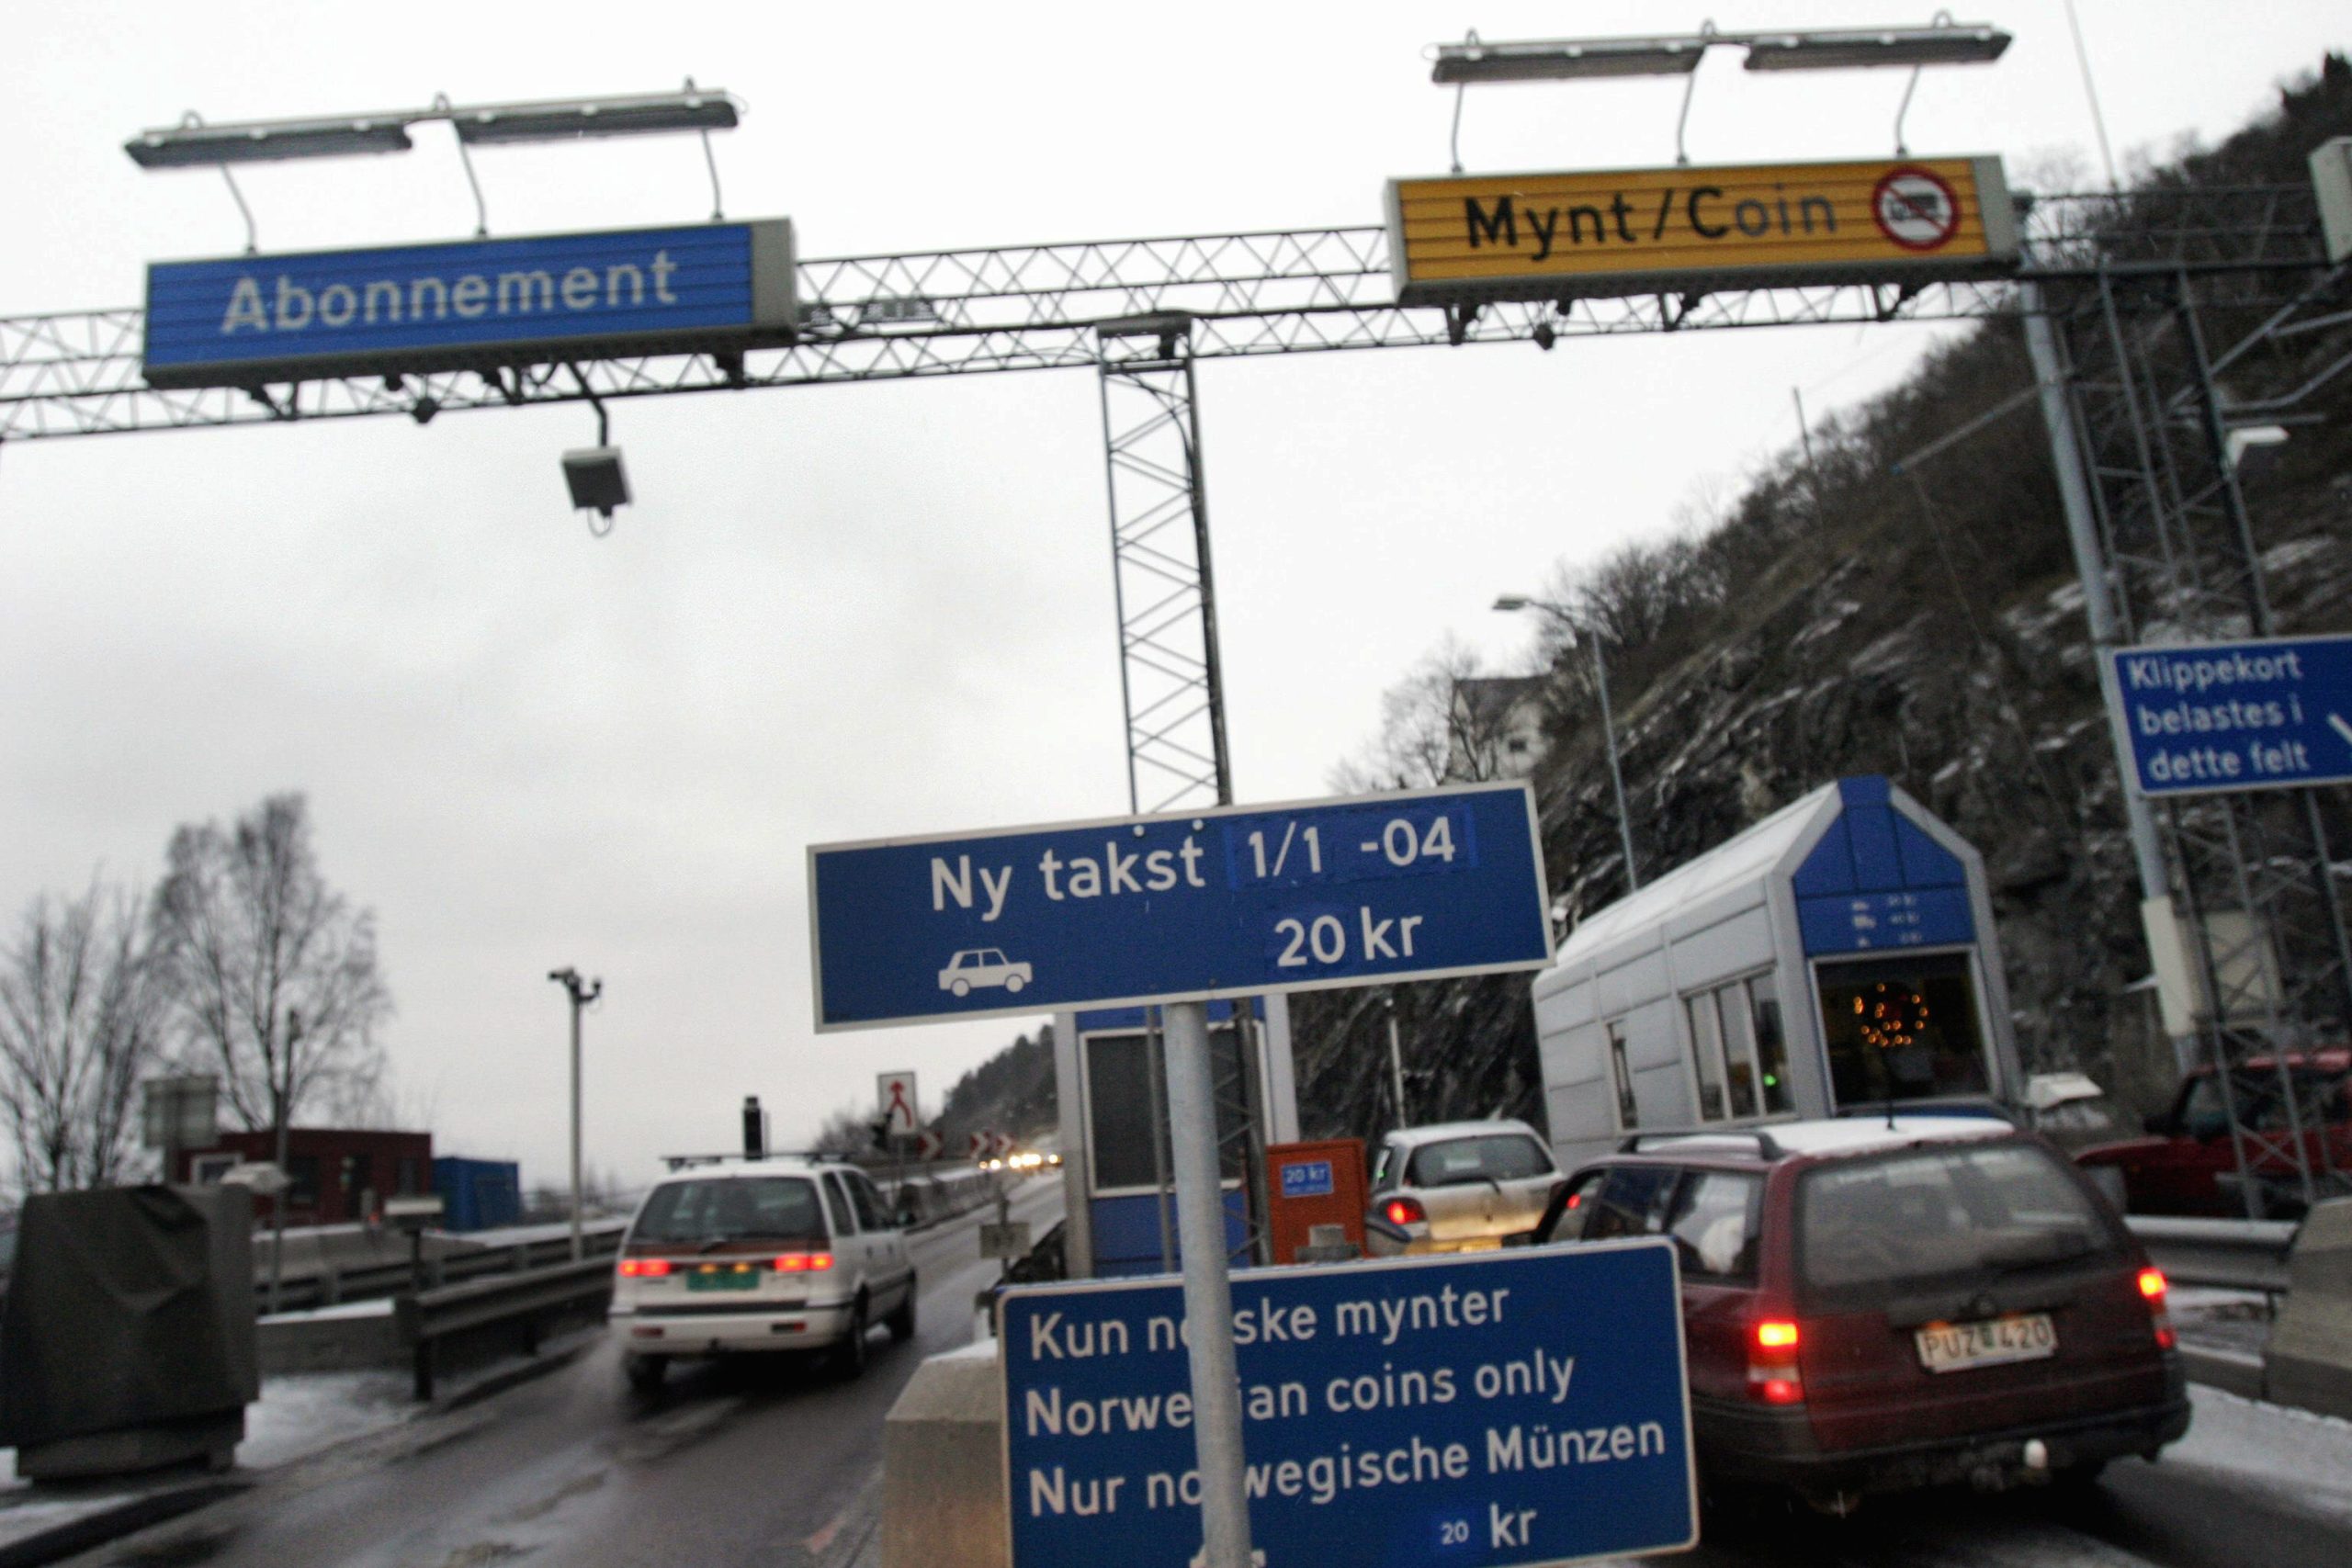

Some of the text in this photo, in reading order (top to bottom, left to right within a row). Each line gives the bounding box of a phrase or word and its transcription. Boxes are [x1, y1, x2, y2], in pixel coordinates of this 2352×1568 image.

[1464, 184, 1837, 261] Mynt/Coin
[222, 250, 679, 333] Abonnement
[2128, 651, 2303, 693] Klippekort
[2137, 693, 2303, 736] belastes i
[2148, 739, 2310, 781] dette felt
[931, 815, 1456, 922] Ny takst 1/1 -04
[1275, 906, 1424, 968] 20 kr
[1030, 1284, 1511, 1361] Kun nske mynter
[1025, 1348, 1576, 1436] Norweian coins only
[1029, 1421, 1666, 1517] Nur nowegische Münzen
[1441, 1504, 1537, 1548] 20 kr
